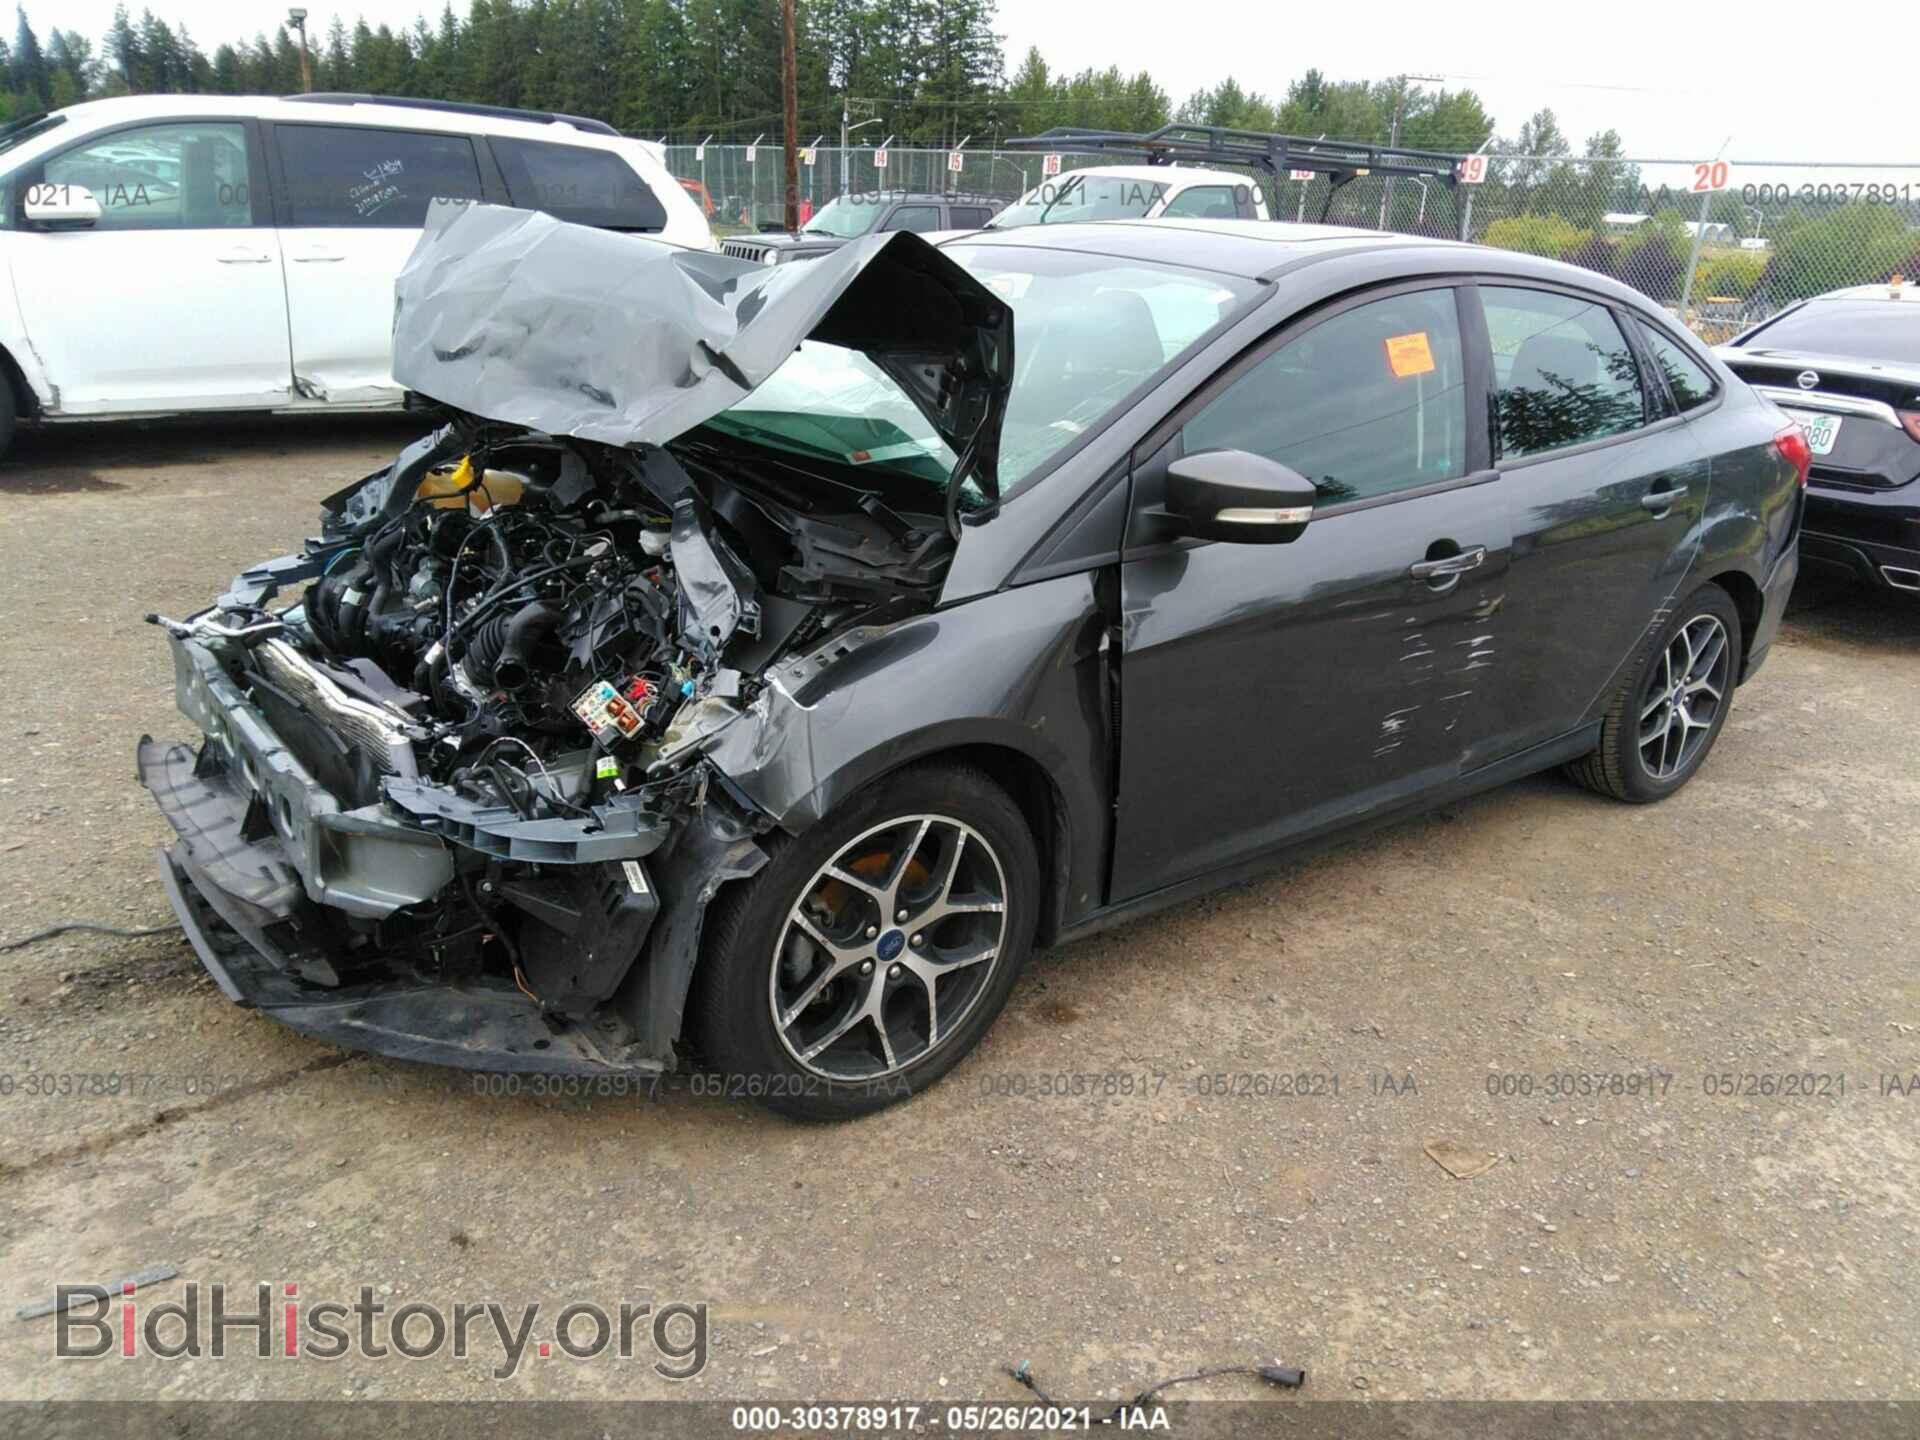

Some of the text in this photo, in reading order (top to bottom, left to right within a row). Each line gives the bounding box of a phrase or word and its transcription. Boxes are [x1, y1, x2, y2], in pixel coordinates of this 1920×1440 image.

[951, 154, 961, 169] 15
[1047, 155, 1058, 172] 16
[1694, 161, 1728, 191] 20
